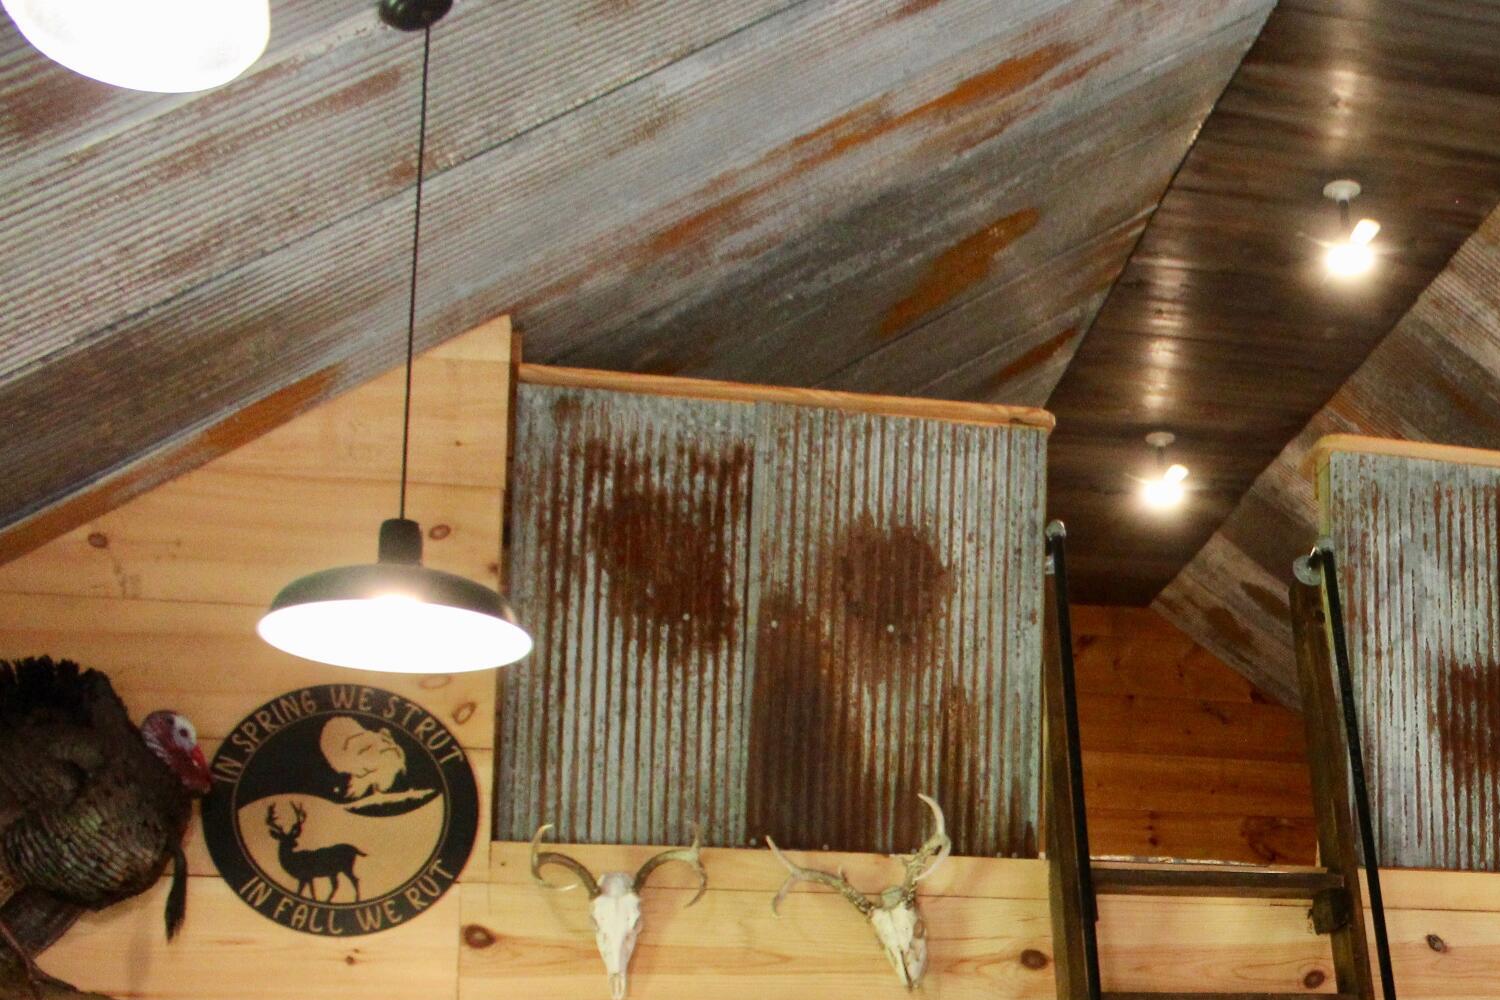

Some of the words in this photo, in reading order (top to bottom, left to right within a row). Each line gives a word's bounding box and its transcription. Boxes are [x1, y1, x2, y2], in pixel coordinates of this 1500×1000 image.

[213, 755, 242, 784] IN
[232, 690, 318, 753] SPRING
[330, 686, 376, 712] WE
[382, 696, 466, 765] STRUT
[239, 876, 273, 902] IN
[272, 898, 345, 935] FALL
[355, 900, 403, 932] WE
[404, 858, 455, 912] RUT
